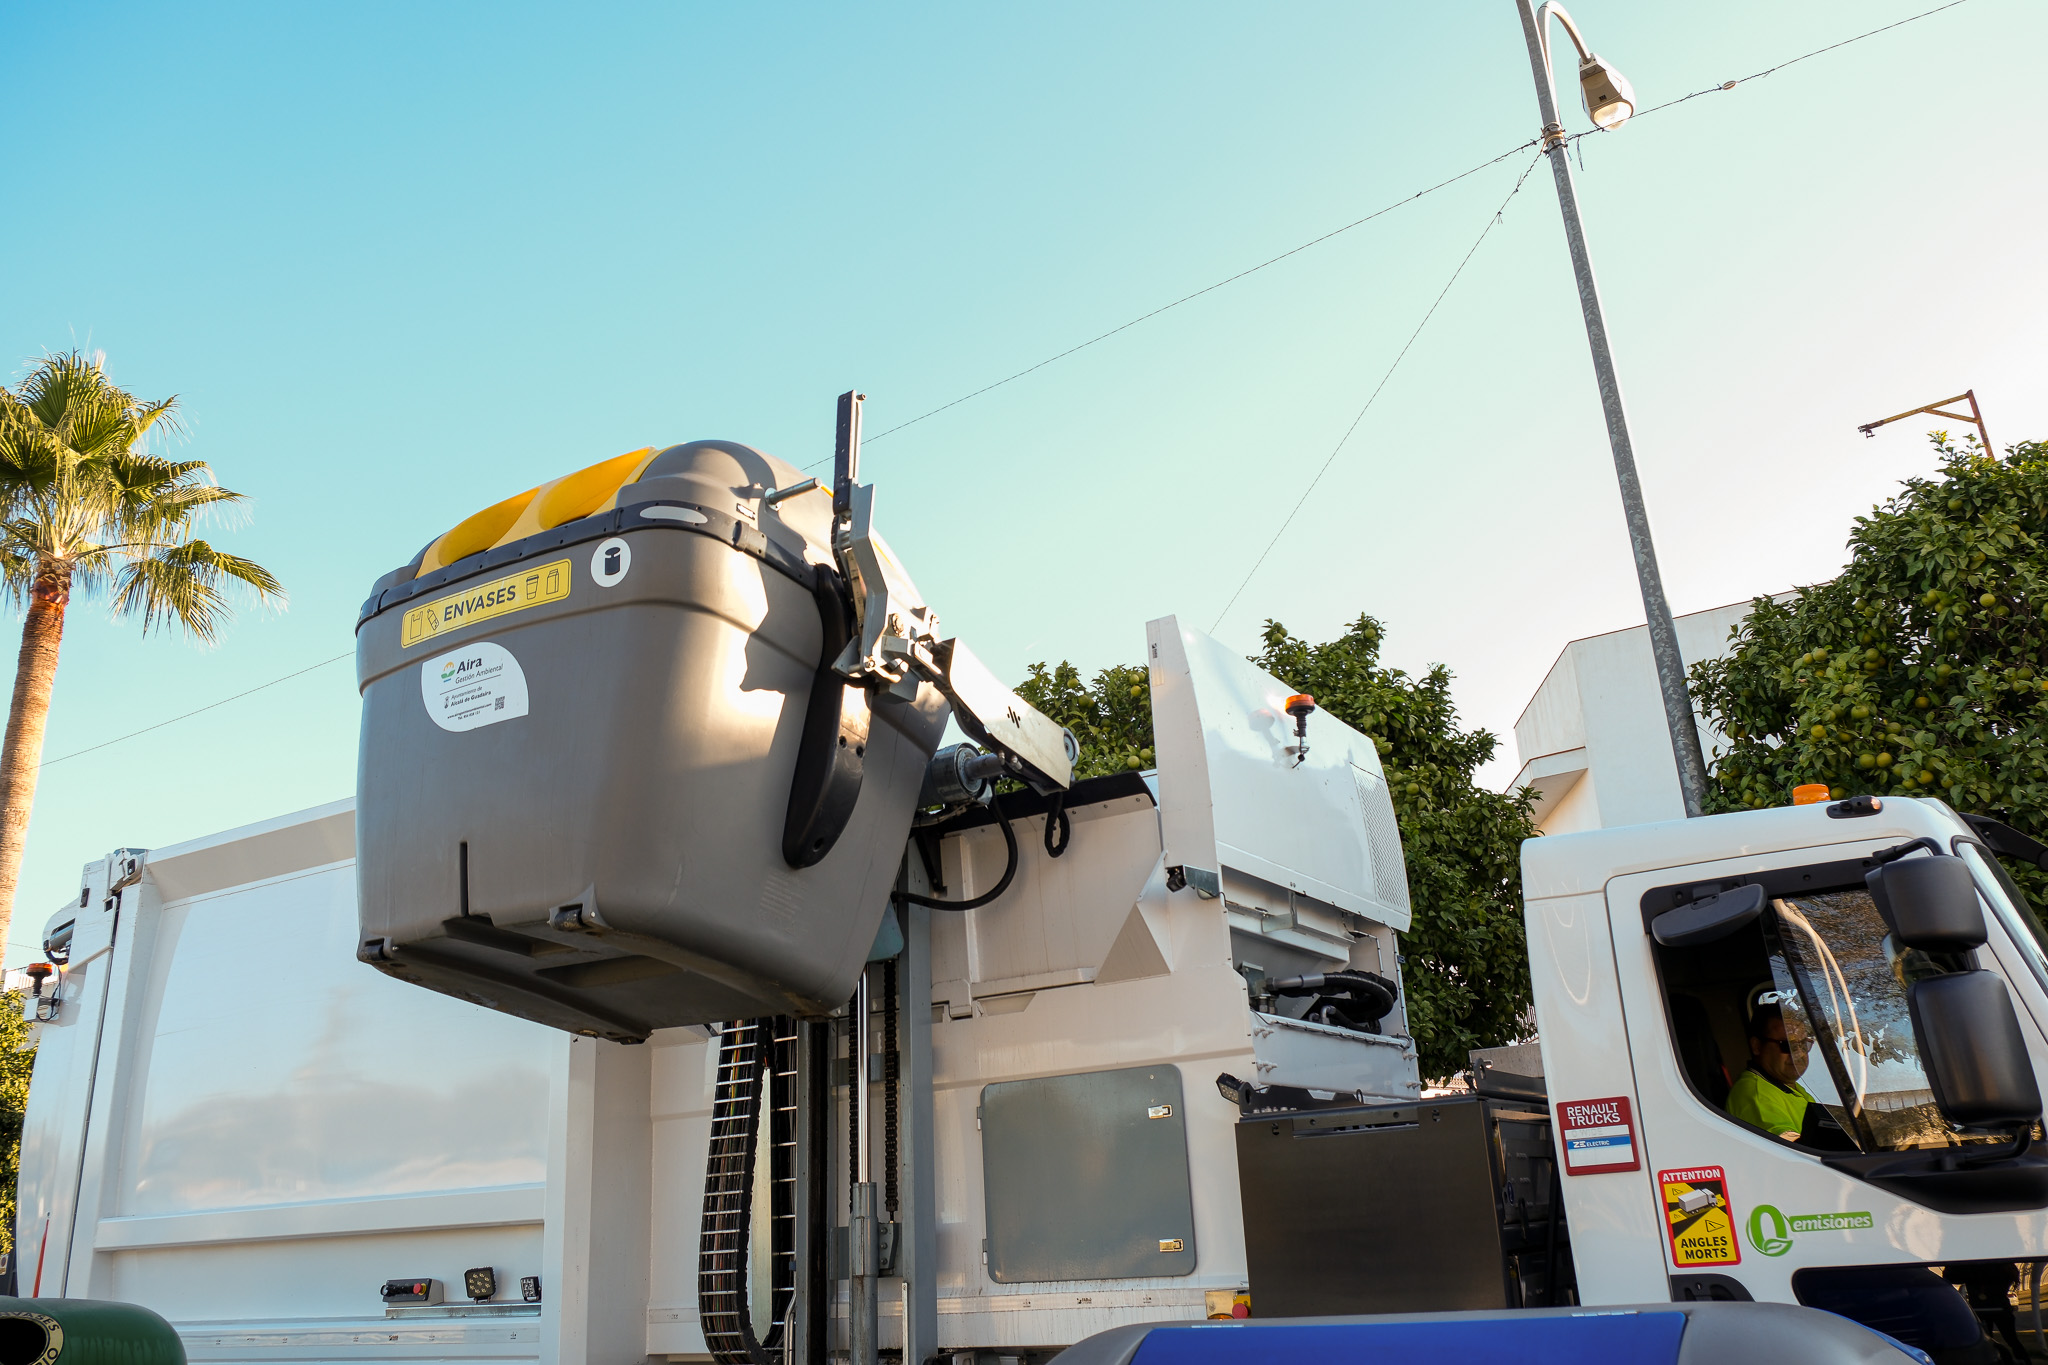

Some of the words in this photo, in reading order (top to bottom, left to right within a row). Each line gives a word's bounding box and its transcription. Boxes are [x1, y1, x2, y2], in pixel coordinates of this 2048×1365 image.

[444, 585, 516, 622] ENVASES
[456, 657, 482, 674] Aira
[455, 673, 475, 684] Gestión
[475, 663, 504, 678] Ambiental
[1566, 1102, 1618, 1117] RENAULT
[1568, 1112, 1621, 1127] TRUCKS
[1663, 1169, 1721, 1182] ATTENTION
[1793, 1214, 1871, 1231] emisiones
[1681, 1236, 1728, 1248] ANGLES
[1684, 1248, 1728, 1260] MORTS
